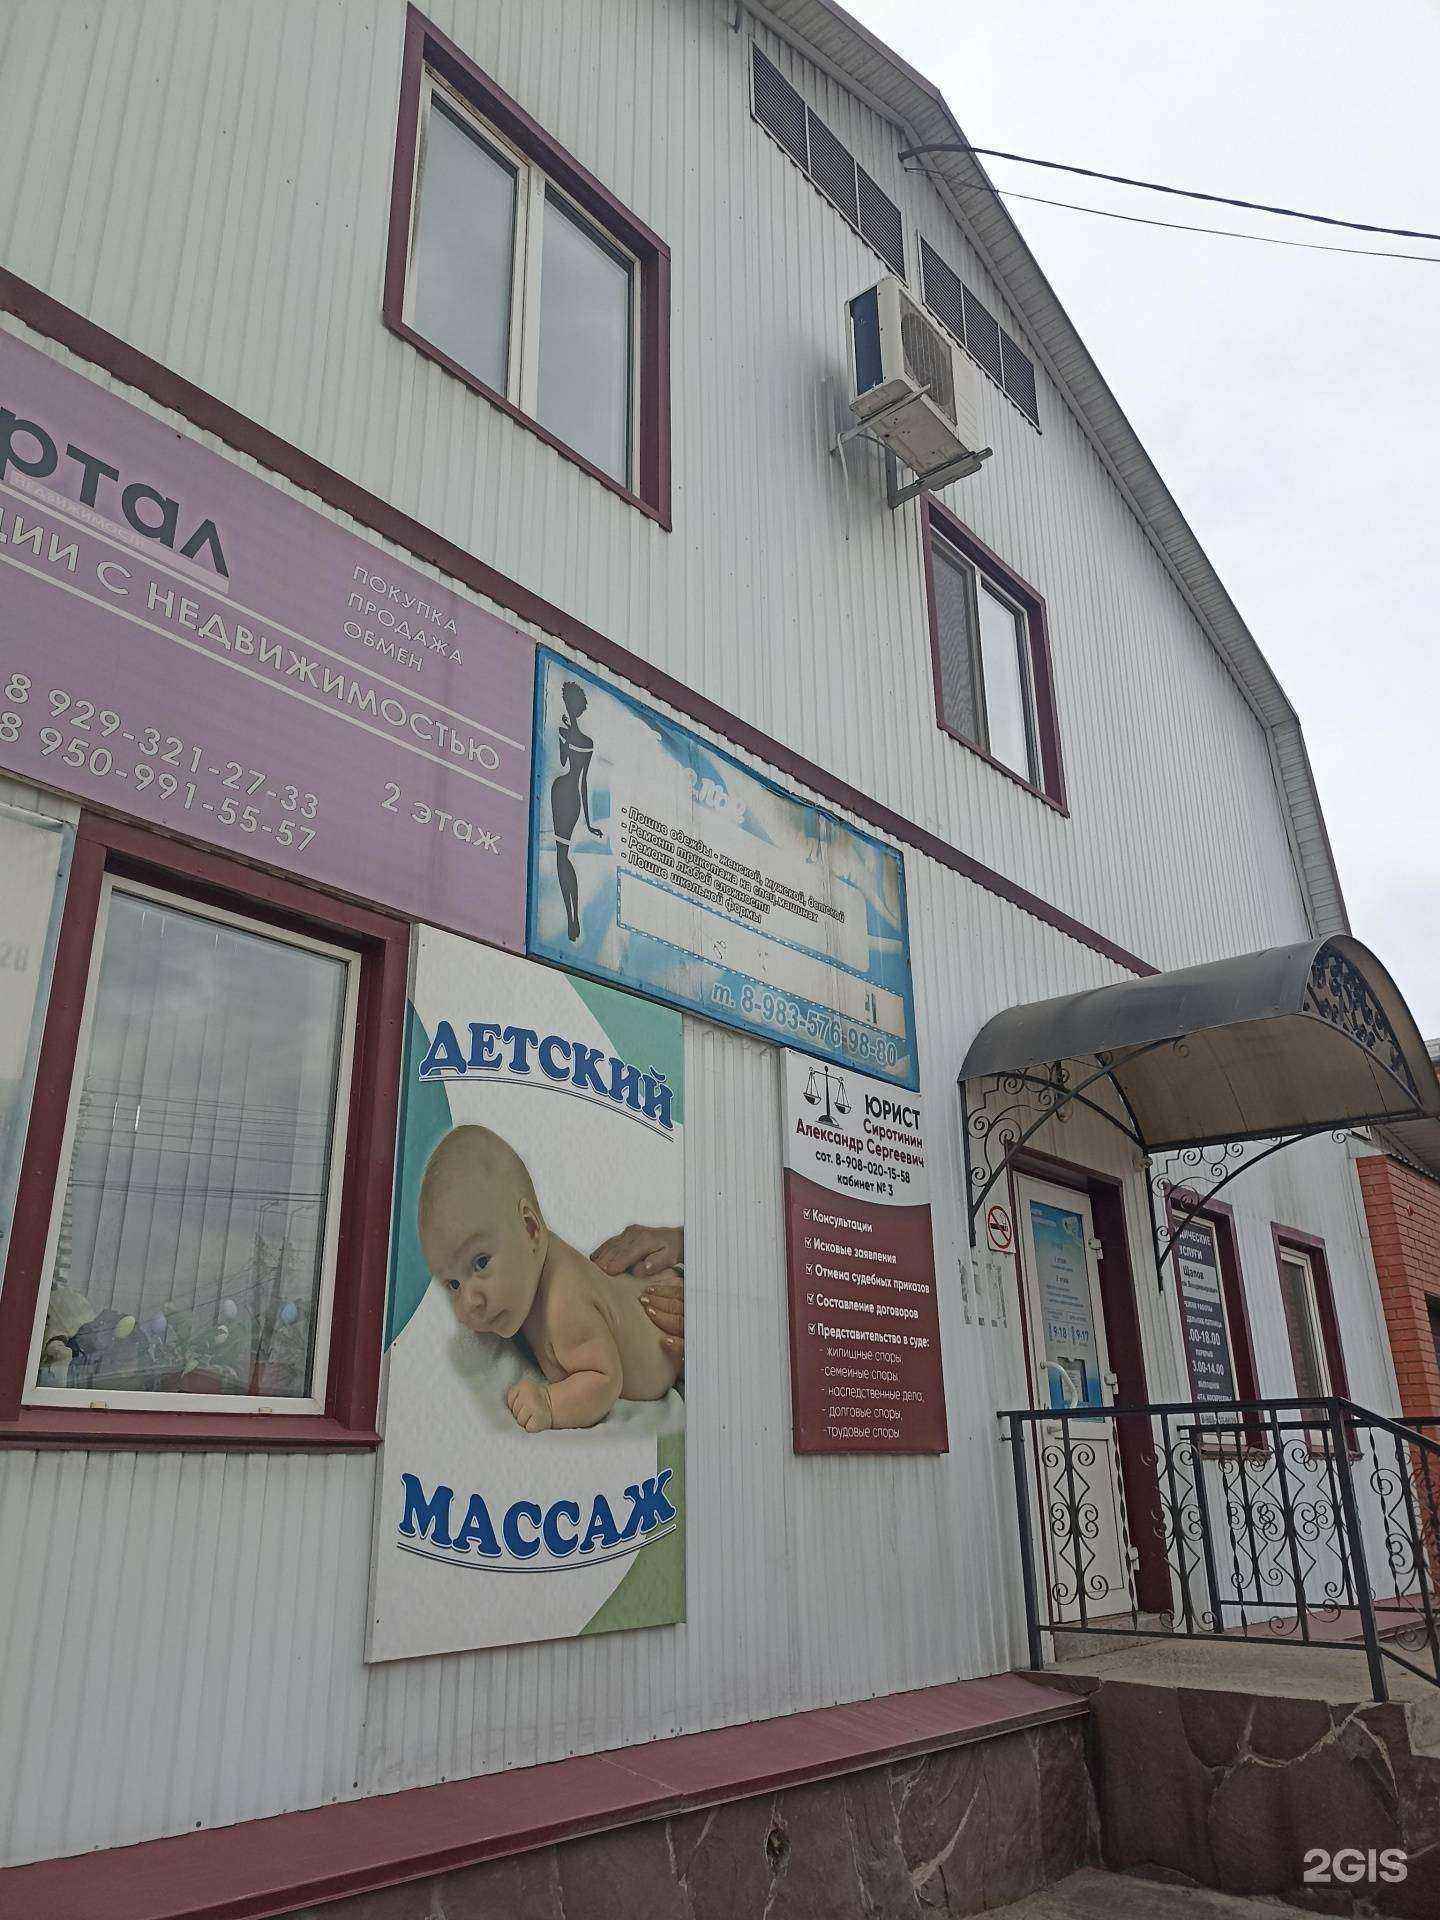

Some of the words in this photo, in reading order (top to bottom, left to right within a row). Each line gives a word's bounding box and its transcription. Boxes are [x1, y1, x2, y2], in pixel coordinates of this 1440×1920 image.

[348, 592, 464, 666] ПРОДАЖА
[352, 565, 459, 636] ПОКУПКА
[97, 560, 132, 595] С
[148, 581, 500, 770] НЕДВИЖИМОСТЬЮ
[343, 621, 424, 672] ОБМЕН
[0, 711, 23, 742] 8
[39, 727, 317, 852] 950-991-55-57
[4, 673, 32, 704] 8
[48, 689, 319, 820] 929-321-27-33
[381, 782, 402, 813] 2
[411, 801, 502, 855] этаж
[627, 836, 675, 868] Ремонт
[676, 860, 713, 886] любой
[713, 878, 771, 914] сложности
[627, 851, 669, 880] Пошив
[669, 872, 724, 905] школьной
[724, 897, 762, 924] формы
[628, 821, 675, 853] Ремонт
[676, 847, 739, 885] трикотажа
[739, 877, 752, 892] на
[628, 806, 669, 836] Пошив
[669, 829, 714, 858] одежды
[807, 895, 845, 923] детской
[740, 984, 899, 1067] 8-983-576-98-80
[418, 1019, 676, 1132] ДЕТСКИЙ
[796, 1118, 864, 1154] Александр
[866, 1139, 925, 1168] Сергеевич
[863, 1118, 923, 1149] Сиротинин
[864, 1094, 921, 1130] ЮРИСТ
[815, 1150, 834, 1164] сот.
[835, 1153, 911, 1184] 8-908-020-15-58
[837, 1174, 875, 1192] кабинет
[888, 1183, 894, 1196] 3
[812, 1209, 873, 1233] Консультации
[813, 1238, 853, 1257] Исковые
[853, 1247, 897, 1264] заявления
[815, 1264, 850, 1281] Отмена
[851, 1271, 892, 1288] судебных
[893, 1279, 930, 1294] приказов
[816, 1293, 875, 1313] Составление
[876, 1304, 919, 1320] договоров
[817, 1322, 901, 1345] Представительство
[903, 1336, 908, 1345] в
[909, 1337, 930, 1348] суде:
[398, 1467, 677, 1560] МАССАЖ
